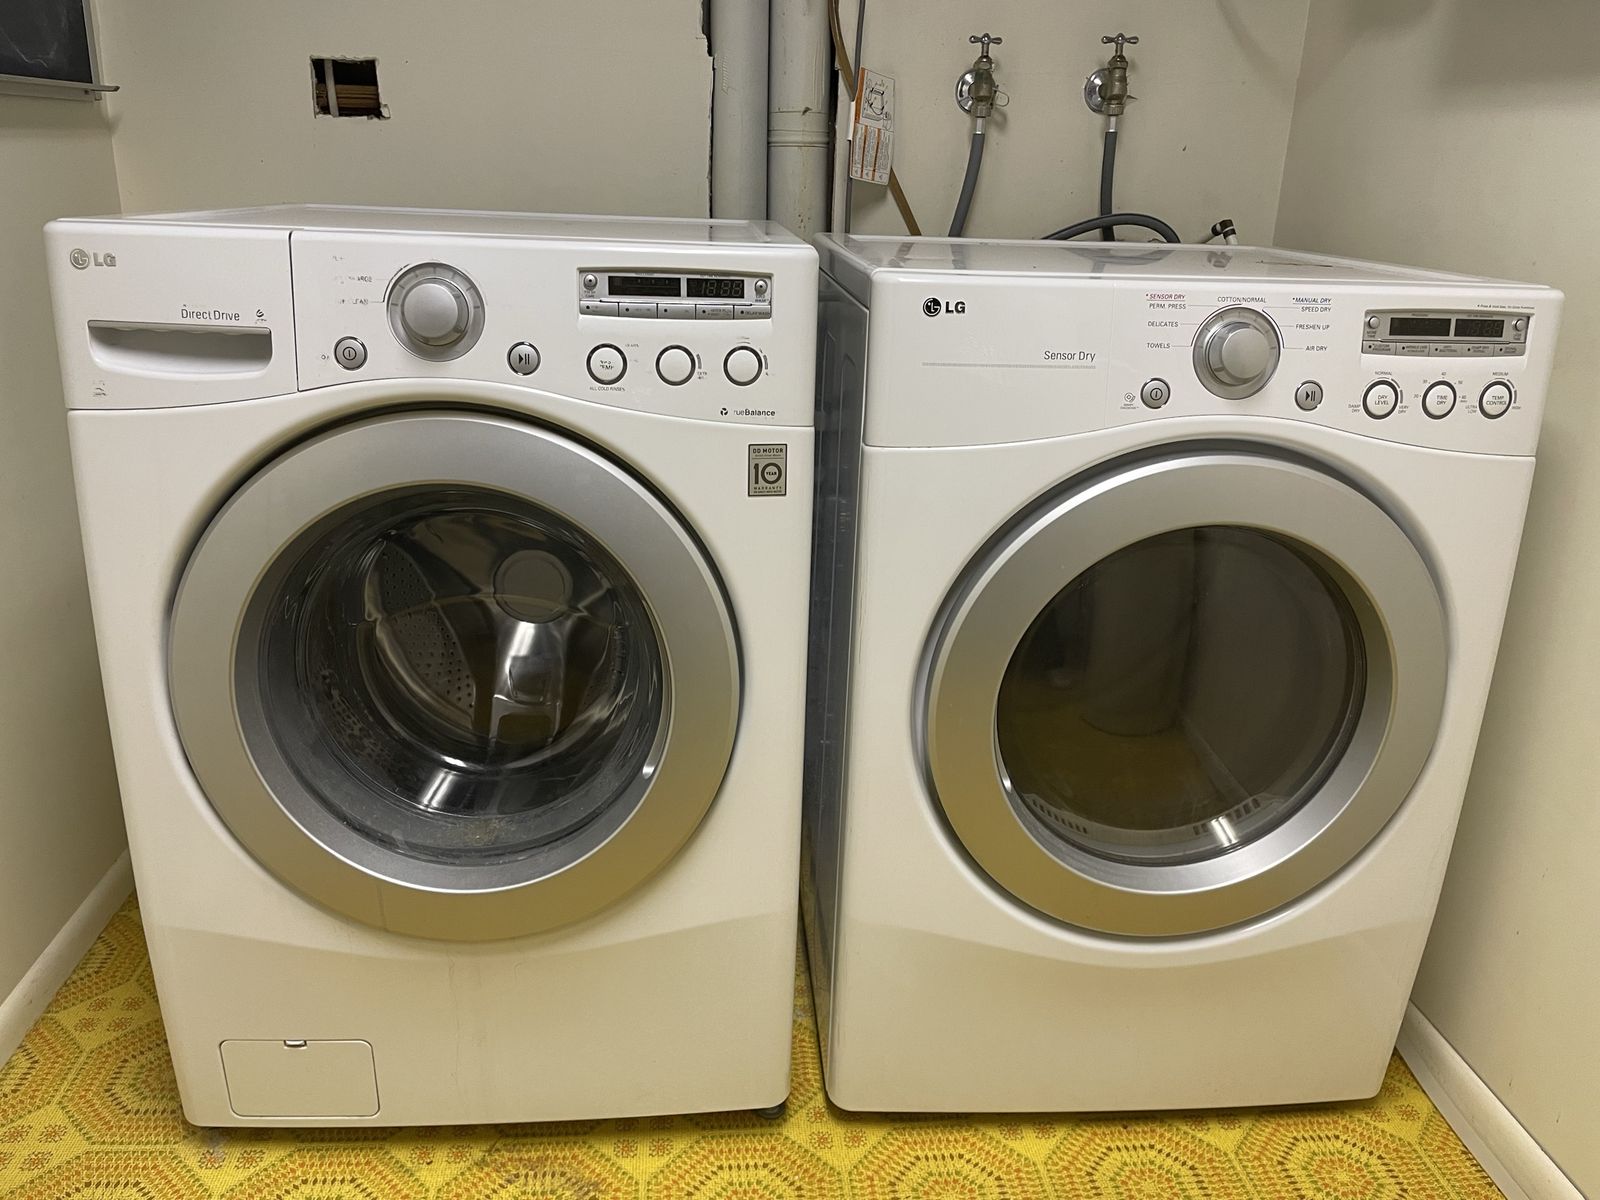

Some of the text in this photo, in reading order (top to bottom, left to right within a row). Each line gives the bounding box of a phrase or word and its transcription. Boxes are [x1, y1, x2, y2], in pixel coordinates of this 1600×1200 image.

[92, 252, 117, 267] LG
[945, 301, 966, 314] LG
[181, 308, 240, 321] Direct Drive
[1295, 323, 1320, 331] FRESHEN
[1044, 350, 1096, 363] Sensor Dry
[753, 462, 783, 485] 10
